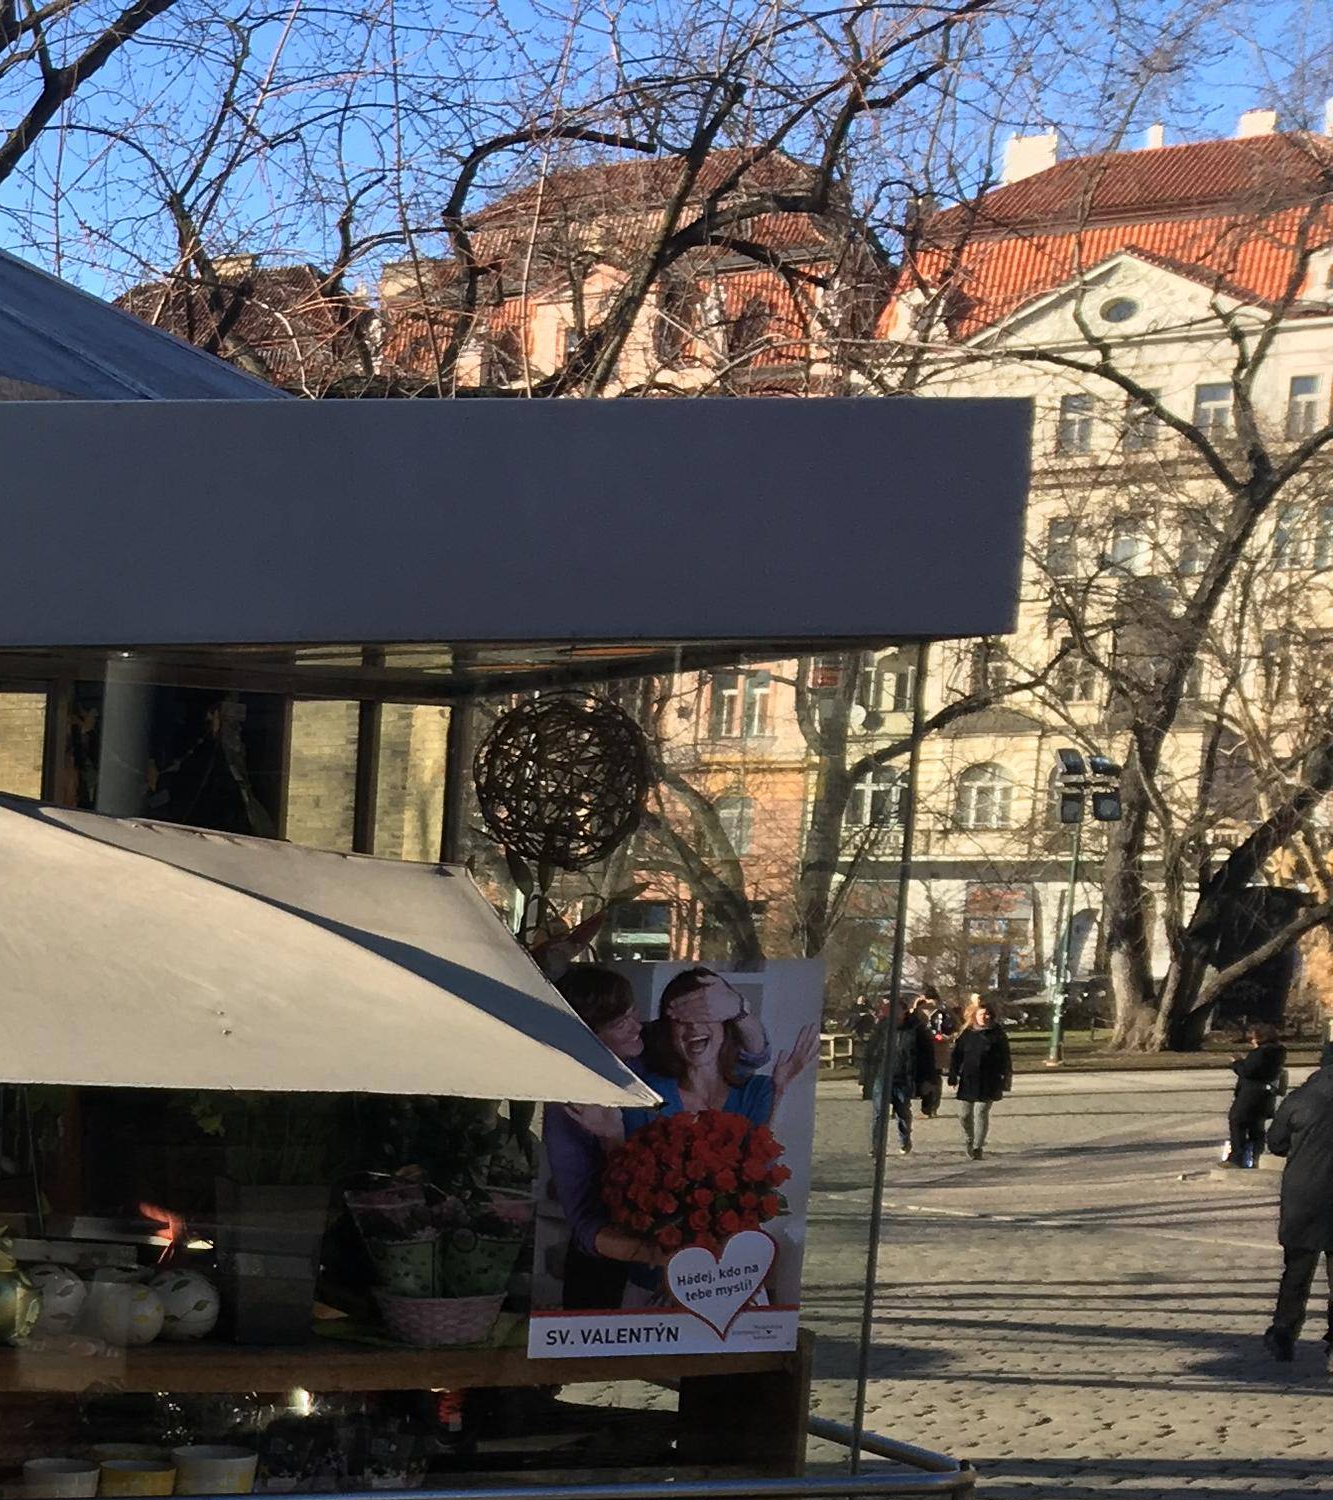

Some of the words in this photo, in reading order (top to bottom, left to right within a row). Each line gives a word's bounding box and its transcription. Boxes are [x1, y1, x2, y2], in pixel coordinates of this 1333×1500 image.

[719, 1266, 741, 1280] kdo
[744, 1264, 759, 1275] na
[685, 1288, 712, 1301] tebe
[545, 1325, 575, 1346] SV.
[579, 1320, 680, 1345] VALENTÝN
